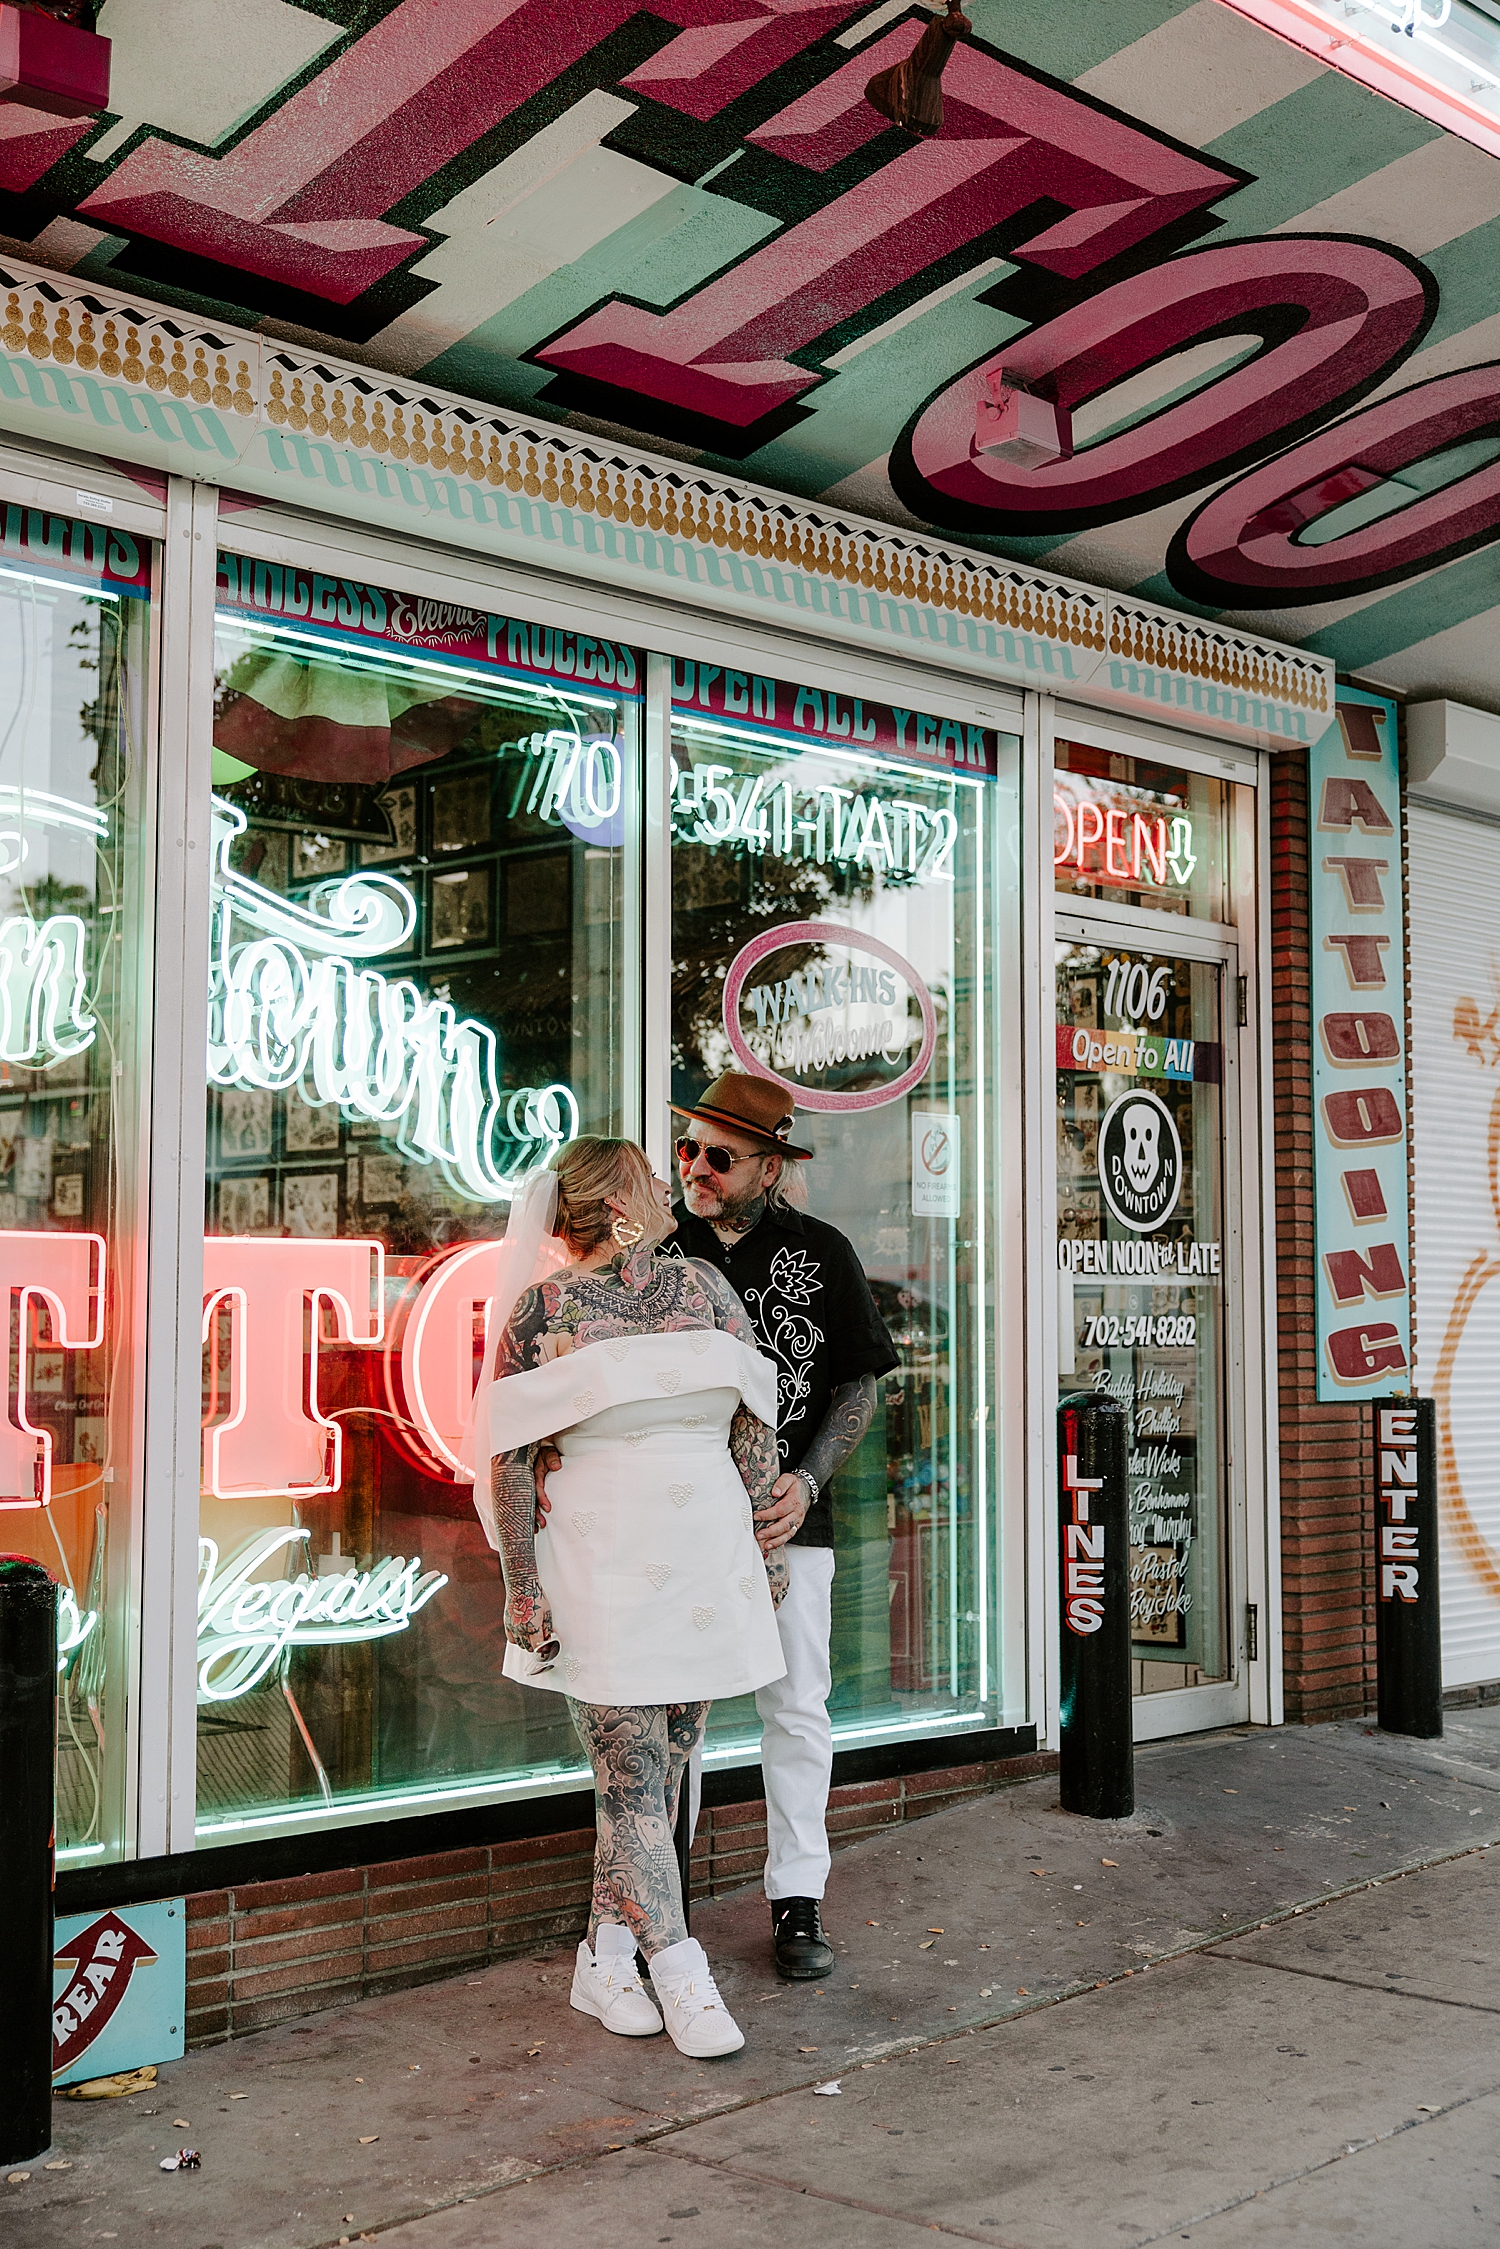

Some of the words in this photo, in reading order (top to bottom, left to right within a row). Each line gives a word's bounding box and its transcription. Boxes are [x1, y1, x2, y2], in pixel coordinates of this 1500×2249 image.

[0, 504, 139, 578] IGNS
[487, 614, 636, 690] PROCESS
[671, 657, 776, 721] OPEN
[793, 686, 876, 742] ALL
[1053, 793, 1166, 885] OPEN
[750, 965, 896, 1027] WALK-INS
[1104, 958, 1173, 1020] 1106
[782, 1016, 914, 1076] Welcome
[1072, 1029, 1131, 1070] Open
[1134, 1038, 1159, 1070] to
[1162, 1040, 1195, 1074] All
[1318, 700, 1408, 1387] TATTOOING
[916, 1181, 927, 1190] NO
[921, 1193, 952, 1203] ALLOWED
[1111, 1155, 1173, 1214] DOWNTOWN
[1058, 1238, 1108, 1274] OPEN
[1112, 1240, 1159, 1275] NOON
[1177, 1241, 1220, 1275] LATE
[1091, 1368, 1136, 1410] Buddy
[1136, 1368, 1185, 1409] Holiday
[1135, 1406, 1181, 1442] Phillips
[1146, 1444, 1182, 1479] Wicks
[1151, 1511, 1196, 1550] Murphy
[1378, 1409, 1420, 1601] ENTER
[1065, 1454, 1106, 1634] LINES
[1141, 1551, 1189, 1583] Pastel
[197, 1526, 449, 1700] Vegas
[1154, 1583, 1194, 1616] Jake
[52, 1929, 127, 2047] REAR
